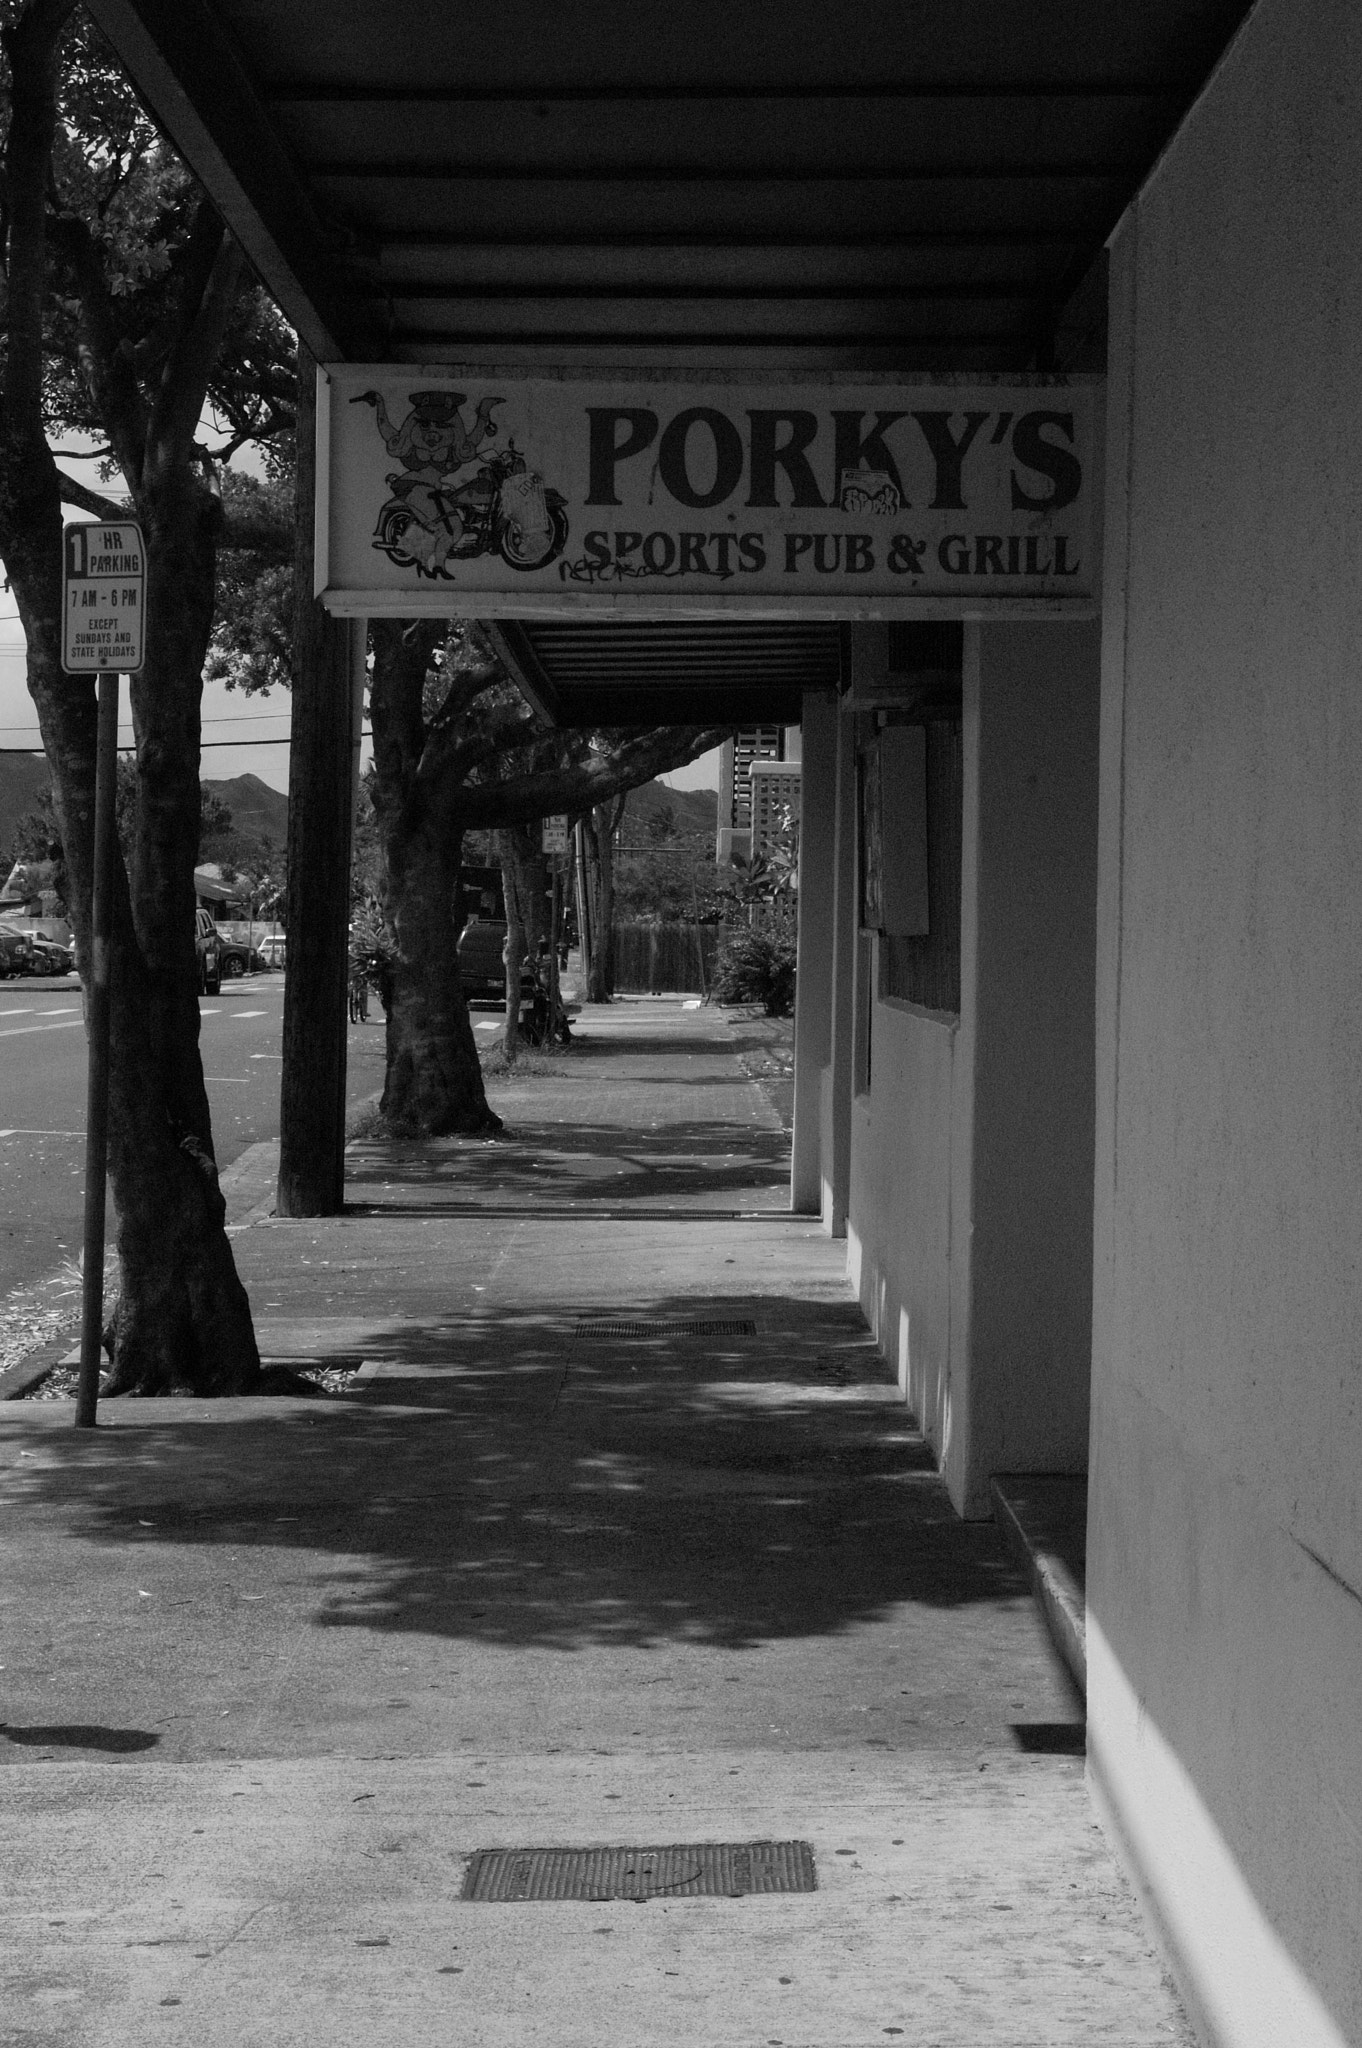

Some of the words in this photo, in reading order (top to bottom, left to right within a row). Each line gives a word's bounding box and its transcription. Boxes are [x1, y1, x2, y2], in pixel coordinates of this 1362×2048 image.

[584, 407, 1081, 511] PORKY'S
[104, 532, 123, 550] HR
[71, 534, 82, 572] 1
[584, 531, 767, 574] SPORTS
[785, 533, 873, 574] PUB
[888, 533, 927, 575] &
[937, 534, 1080, 576] GRILL
[91, 554, 139, 573] PARKING
[72, 590, 78, 607] 7
[82, 590, 97, 607] AM
[111, 589, 118, 607] 6
[122, 589, 137, 606] PM
[89, 618, 118, 630] EXCEPT
[75, 633, 112, 644] SUNDAYS
[115, 632, 131, 643] AND
[72, 647, 95, 658] STATE
[99, 646, 136, 657] HOLIDAYS
